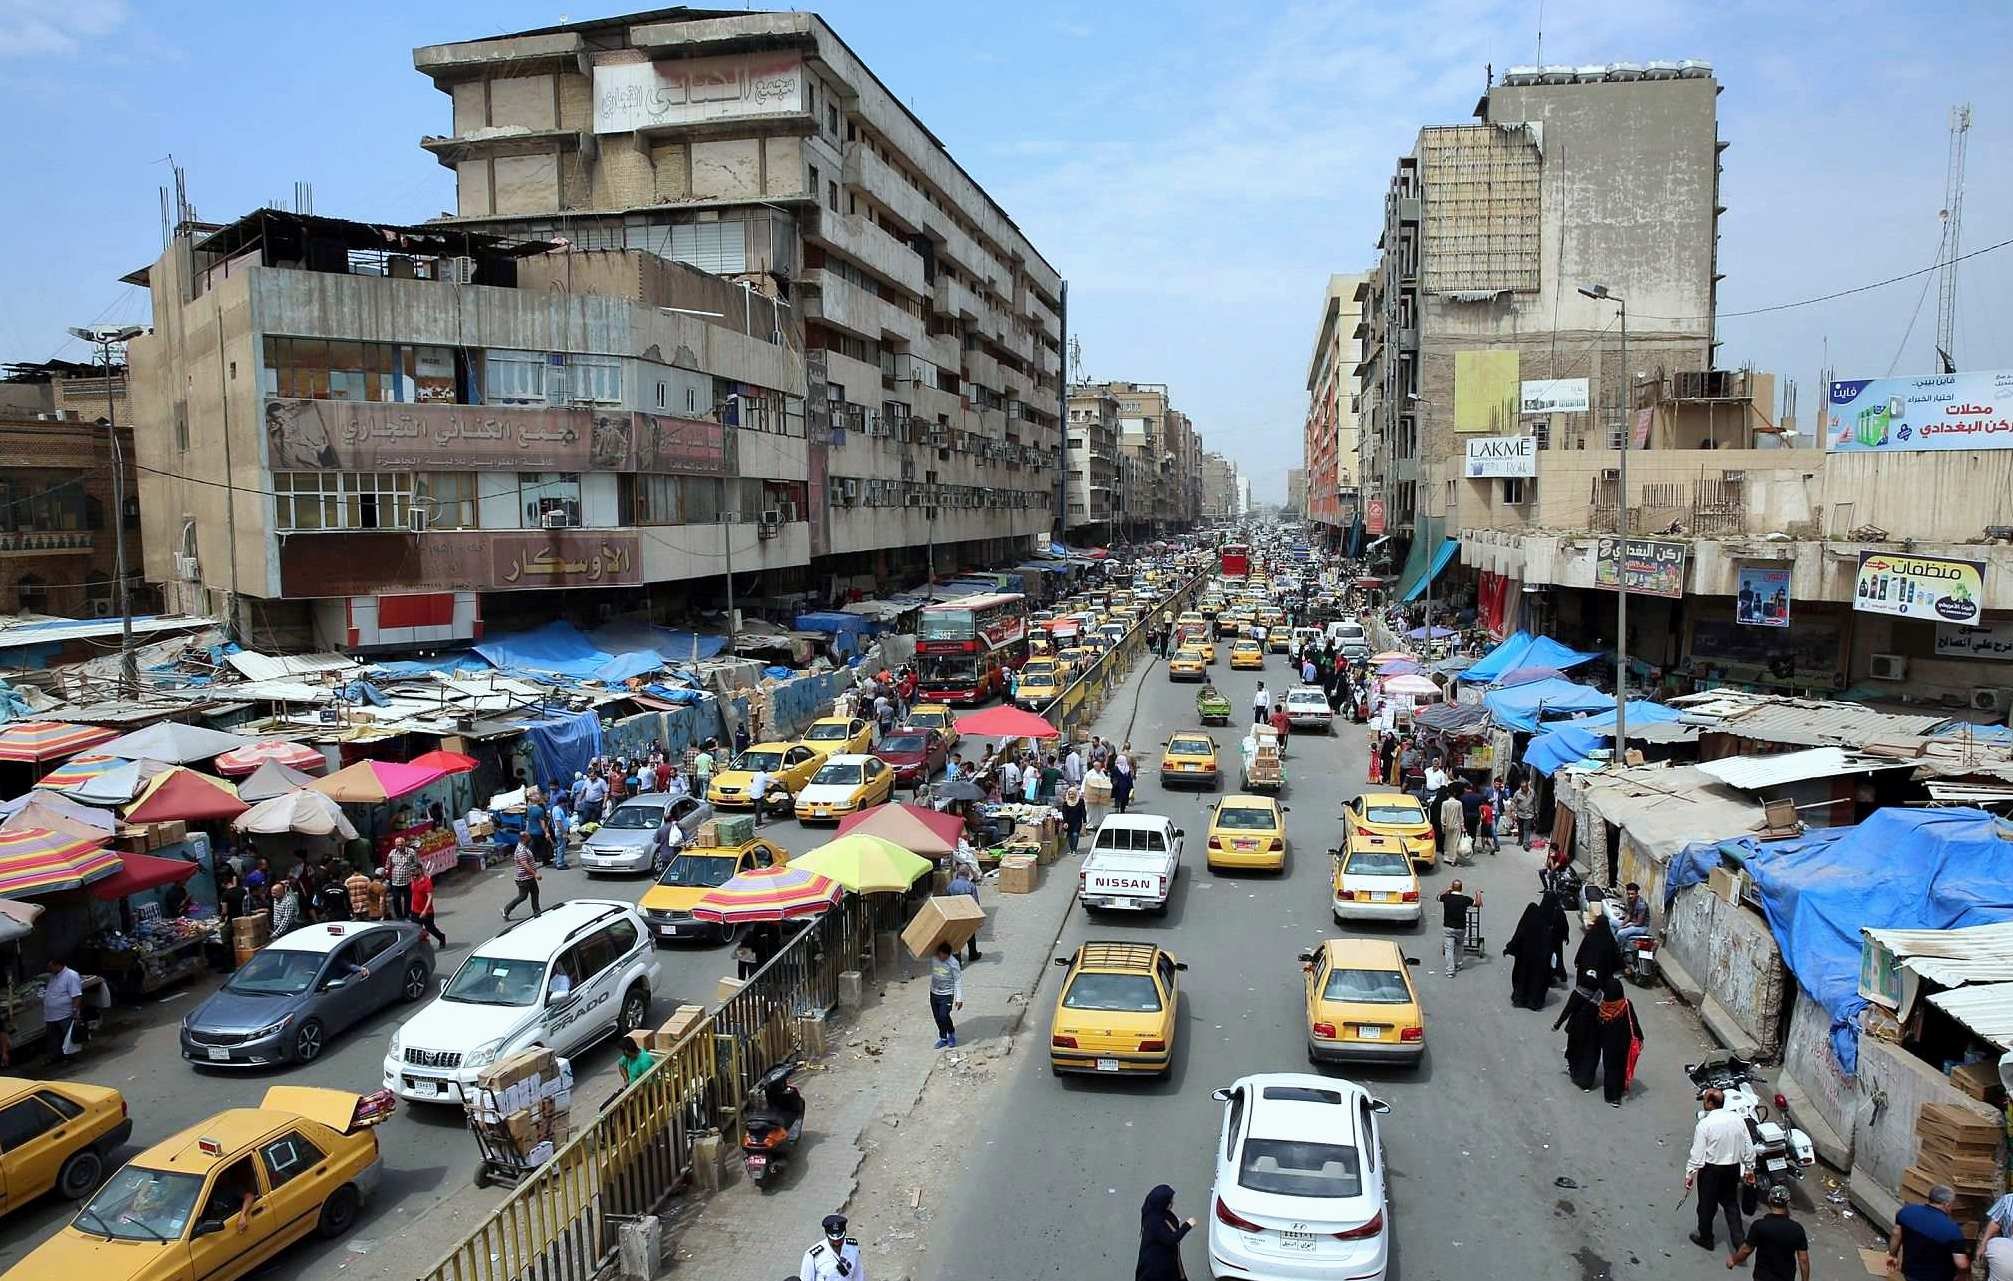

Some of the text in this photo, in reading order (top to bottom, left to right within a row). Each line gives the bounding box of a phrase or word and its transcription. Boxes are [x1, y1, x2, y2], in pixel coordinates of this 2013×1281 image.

[754, 78, 796, 104] مجمع
[1946, 404, 1993, 416] محلات
[342, 415, 428, 446] التجاري
[434, 416, 512, 447] الكناني
[1920, 420, 1983, 439] البغدادي
[503, 537, 630, 582] الأوسكار
[1612, 543, 1682, 563] ركن البغداي
[1892, 559, 1962, 580] منظفات
[1096, 878, 1150, 889] NISSAN
[550, 991, 610, 1036] PRADO
